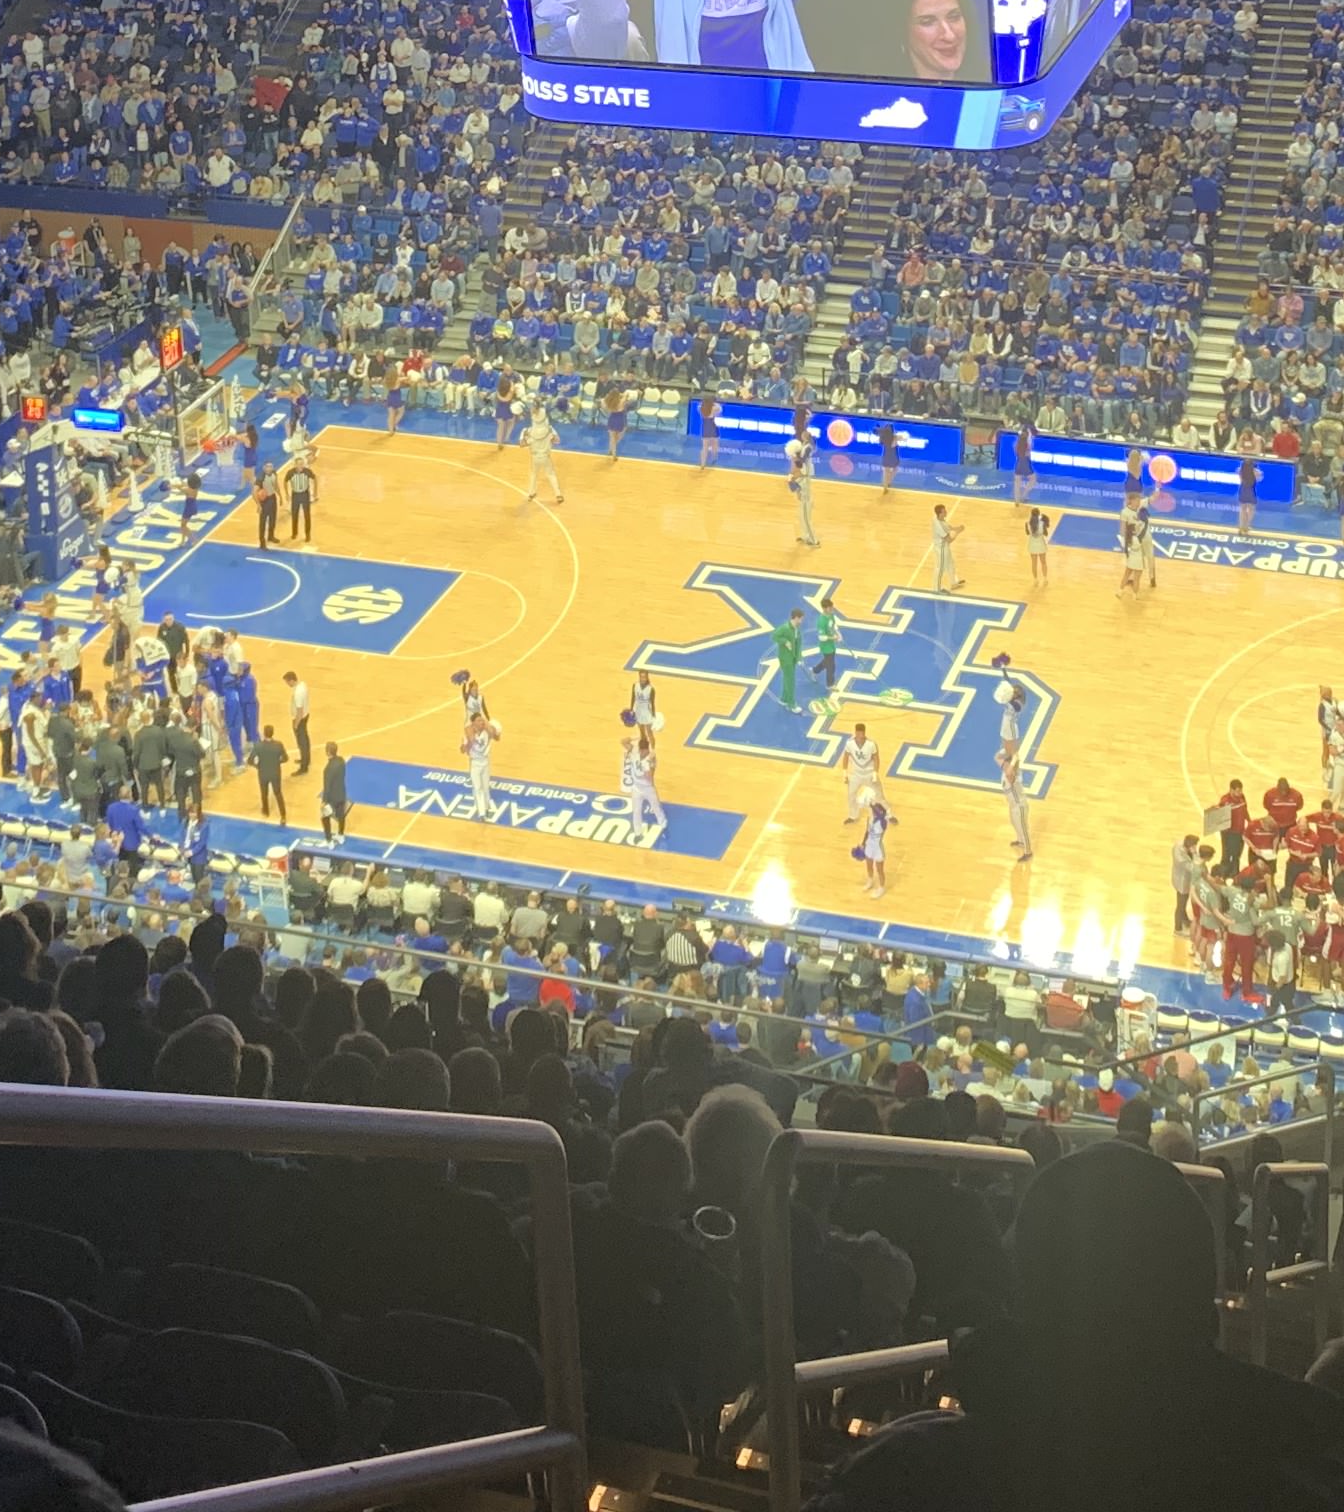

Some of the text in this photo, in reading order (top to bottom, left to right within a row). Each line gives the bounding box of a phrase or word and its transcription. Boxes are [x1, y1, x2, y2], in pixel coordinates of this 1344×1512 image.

[574, 84, 651, 108] STATE
[1150, 525, 1290, 549] Central Bank Cent
[322, 583, 404, 625] SEC
[525, 783, 589, 805] Central
[398, 784, 666, 849] RUPP ARENA
[1279, 915, 1294, 927] 12
